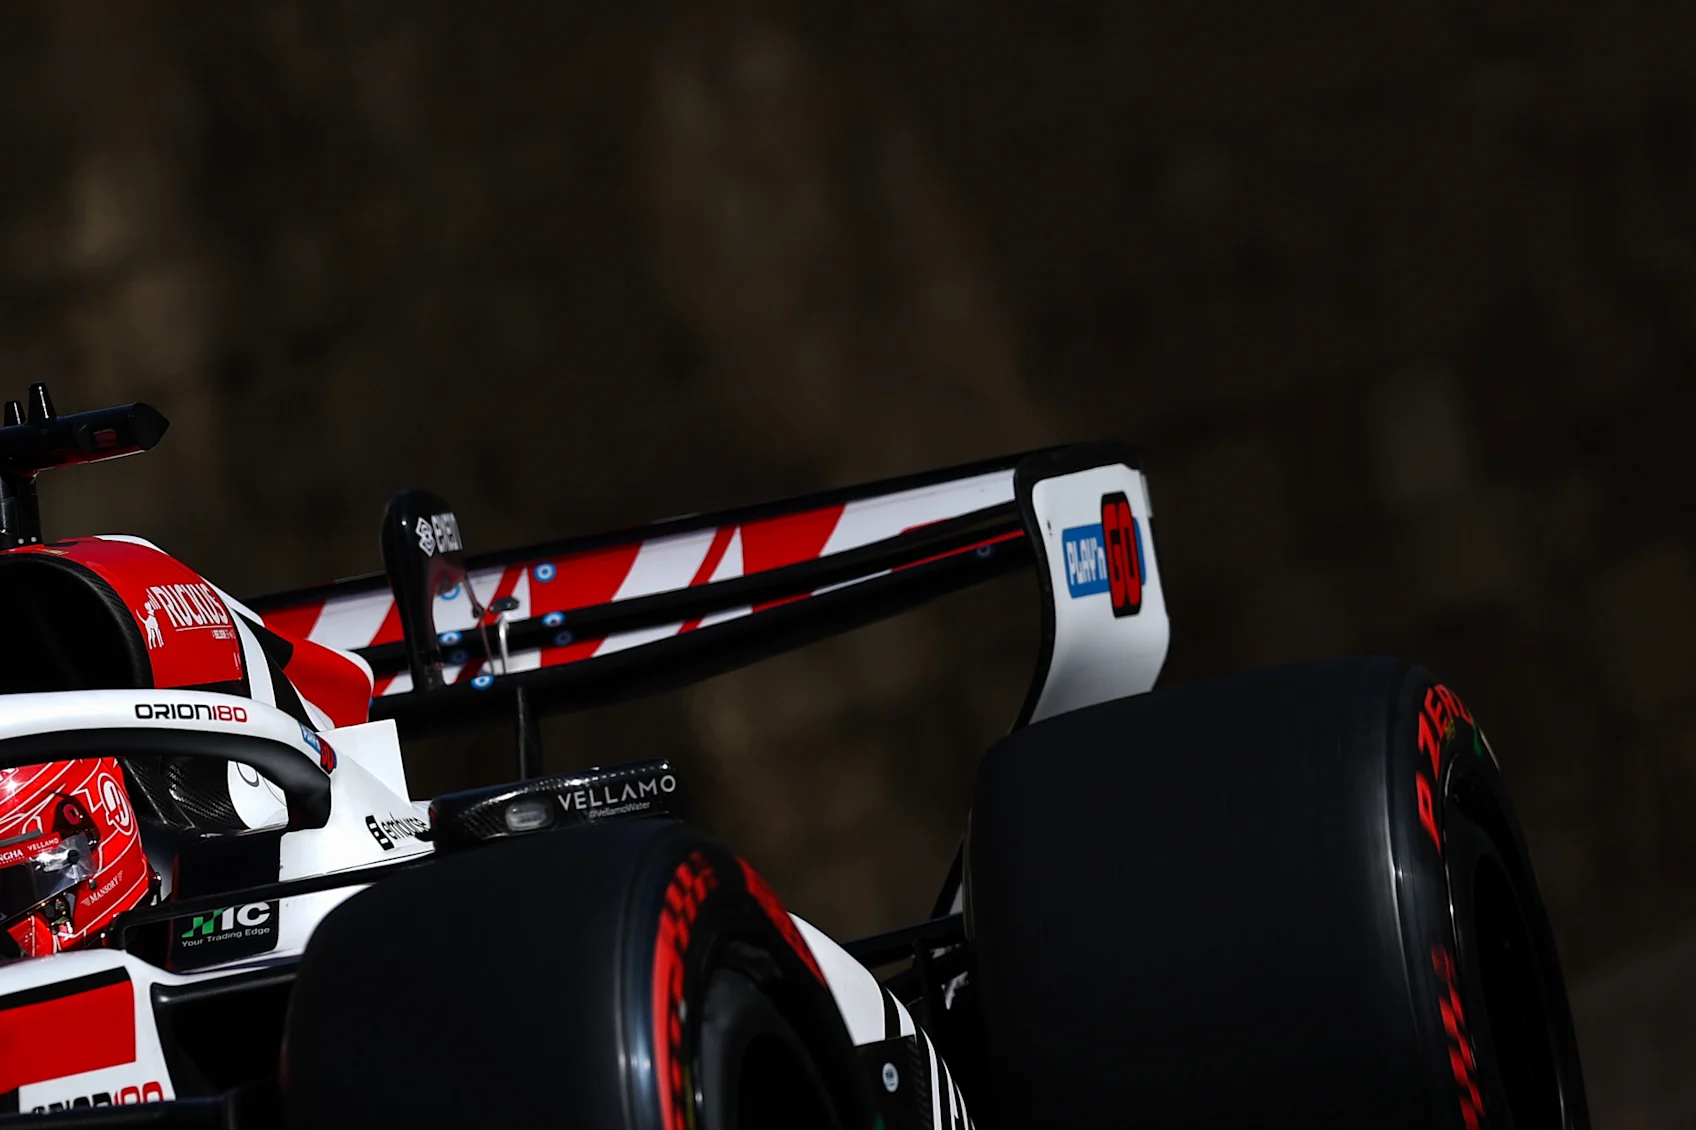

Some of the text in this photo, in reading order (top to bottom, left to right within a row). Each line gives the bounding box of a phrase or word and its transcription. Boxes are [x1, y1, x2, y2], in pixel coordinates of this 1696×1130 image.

[150, 582, 229, 628] RUCKUS
[134, 703, 249, 723] ORION180
[557, 774, 676, 812] VELLAMO
[181, 926, 271, 948] Your Trading Edge
